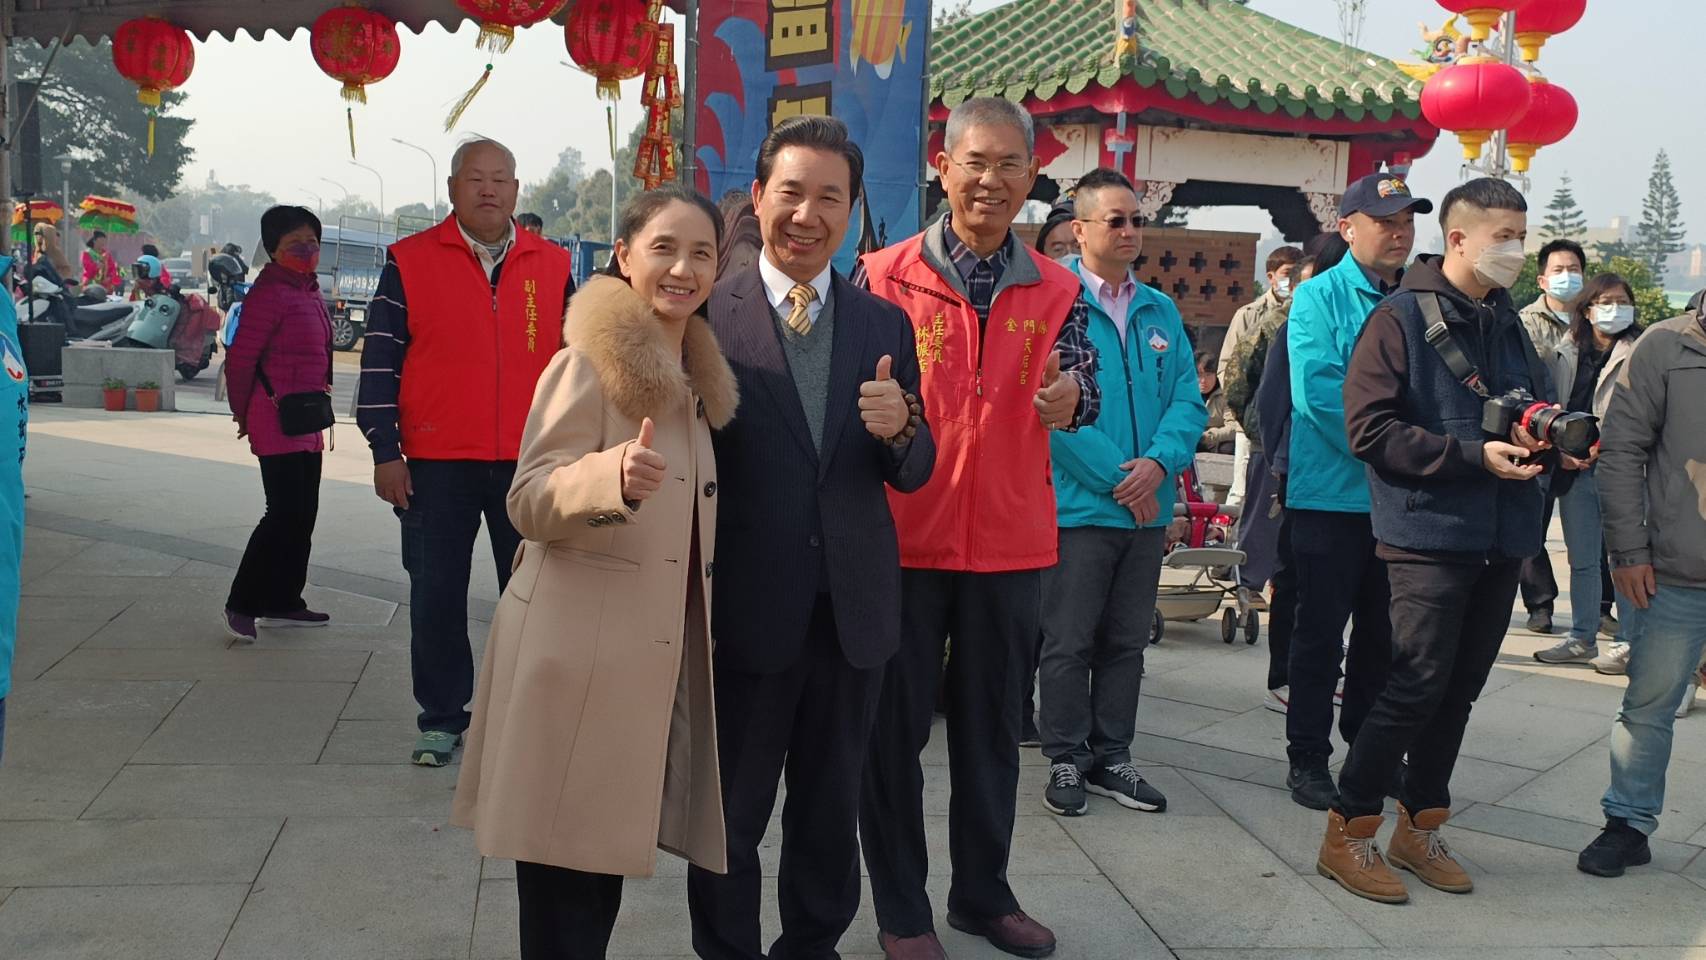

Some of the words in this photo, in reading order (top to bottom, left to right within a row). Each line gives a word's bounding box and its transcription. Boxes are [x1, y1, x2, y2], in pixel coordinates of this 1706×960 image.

[524, 279, 537, 352] 副主任委員
[932, 312, 945, 364] 主任委員
